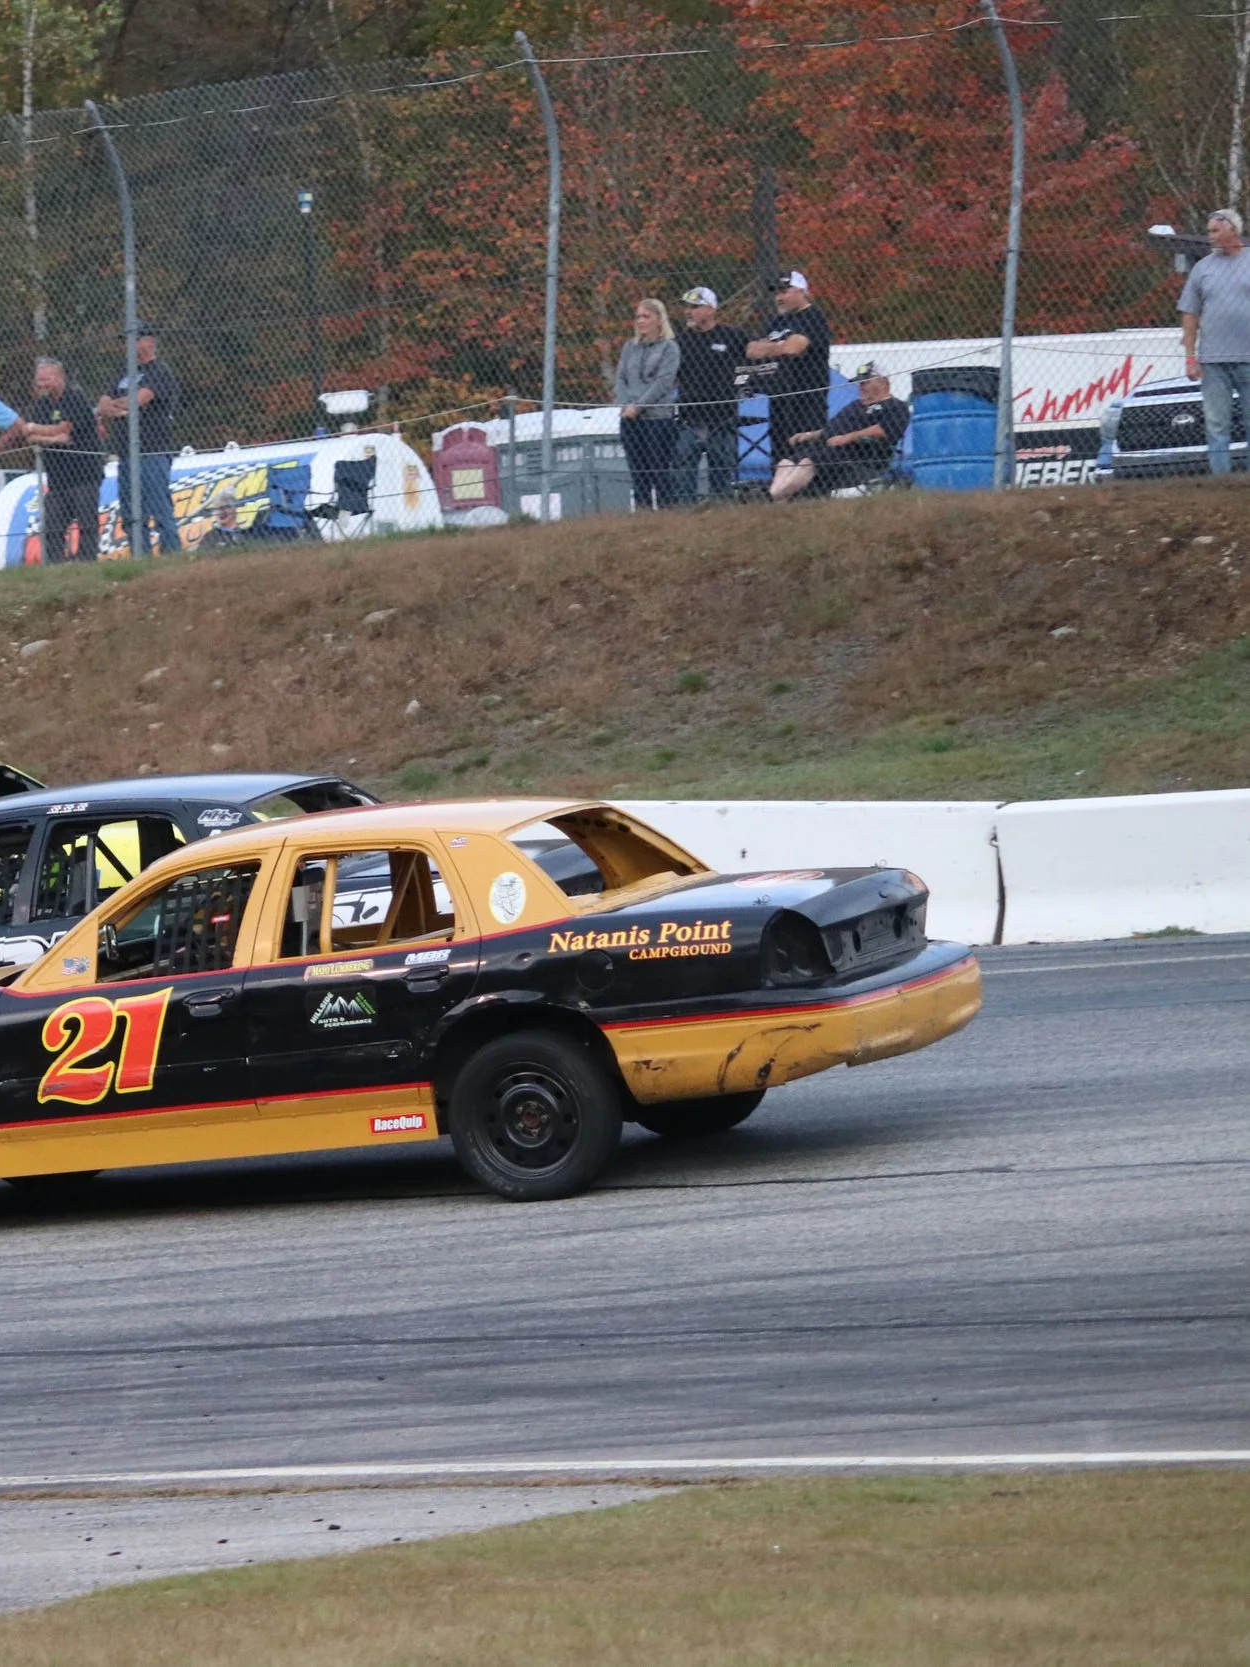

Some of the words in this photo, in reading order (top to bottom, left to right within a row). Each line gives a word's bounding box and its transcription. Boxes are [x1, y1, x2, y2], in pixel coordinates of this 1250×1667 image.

[548, 926, 650, 953] Natanis
[657, 920, 732, 944] Point
[629, 943, 732, 960] CAMPGROUND
[310, 991, 334, 1024] HILLSIDE
[323, 1018, 372, 1028] PERFORMANCE
[37, 986, 174, 1105] 21
[374, 1115, 423, 1132] RaceQuip
